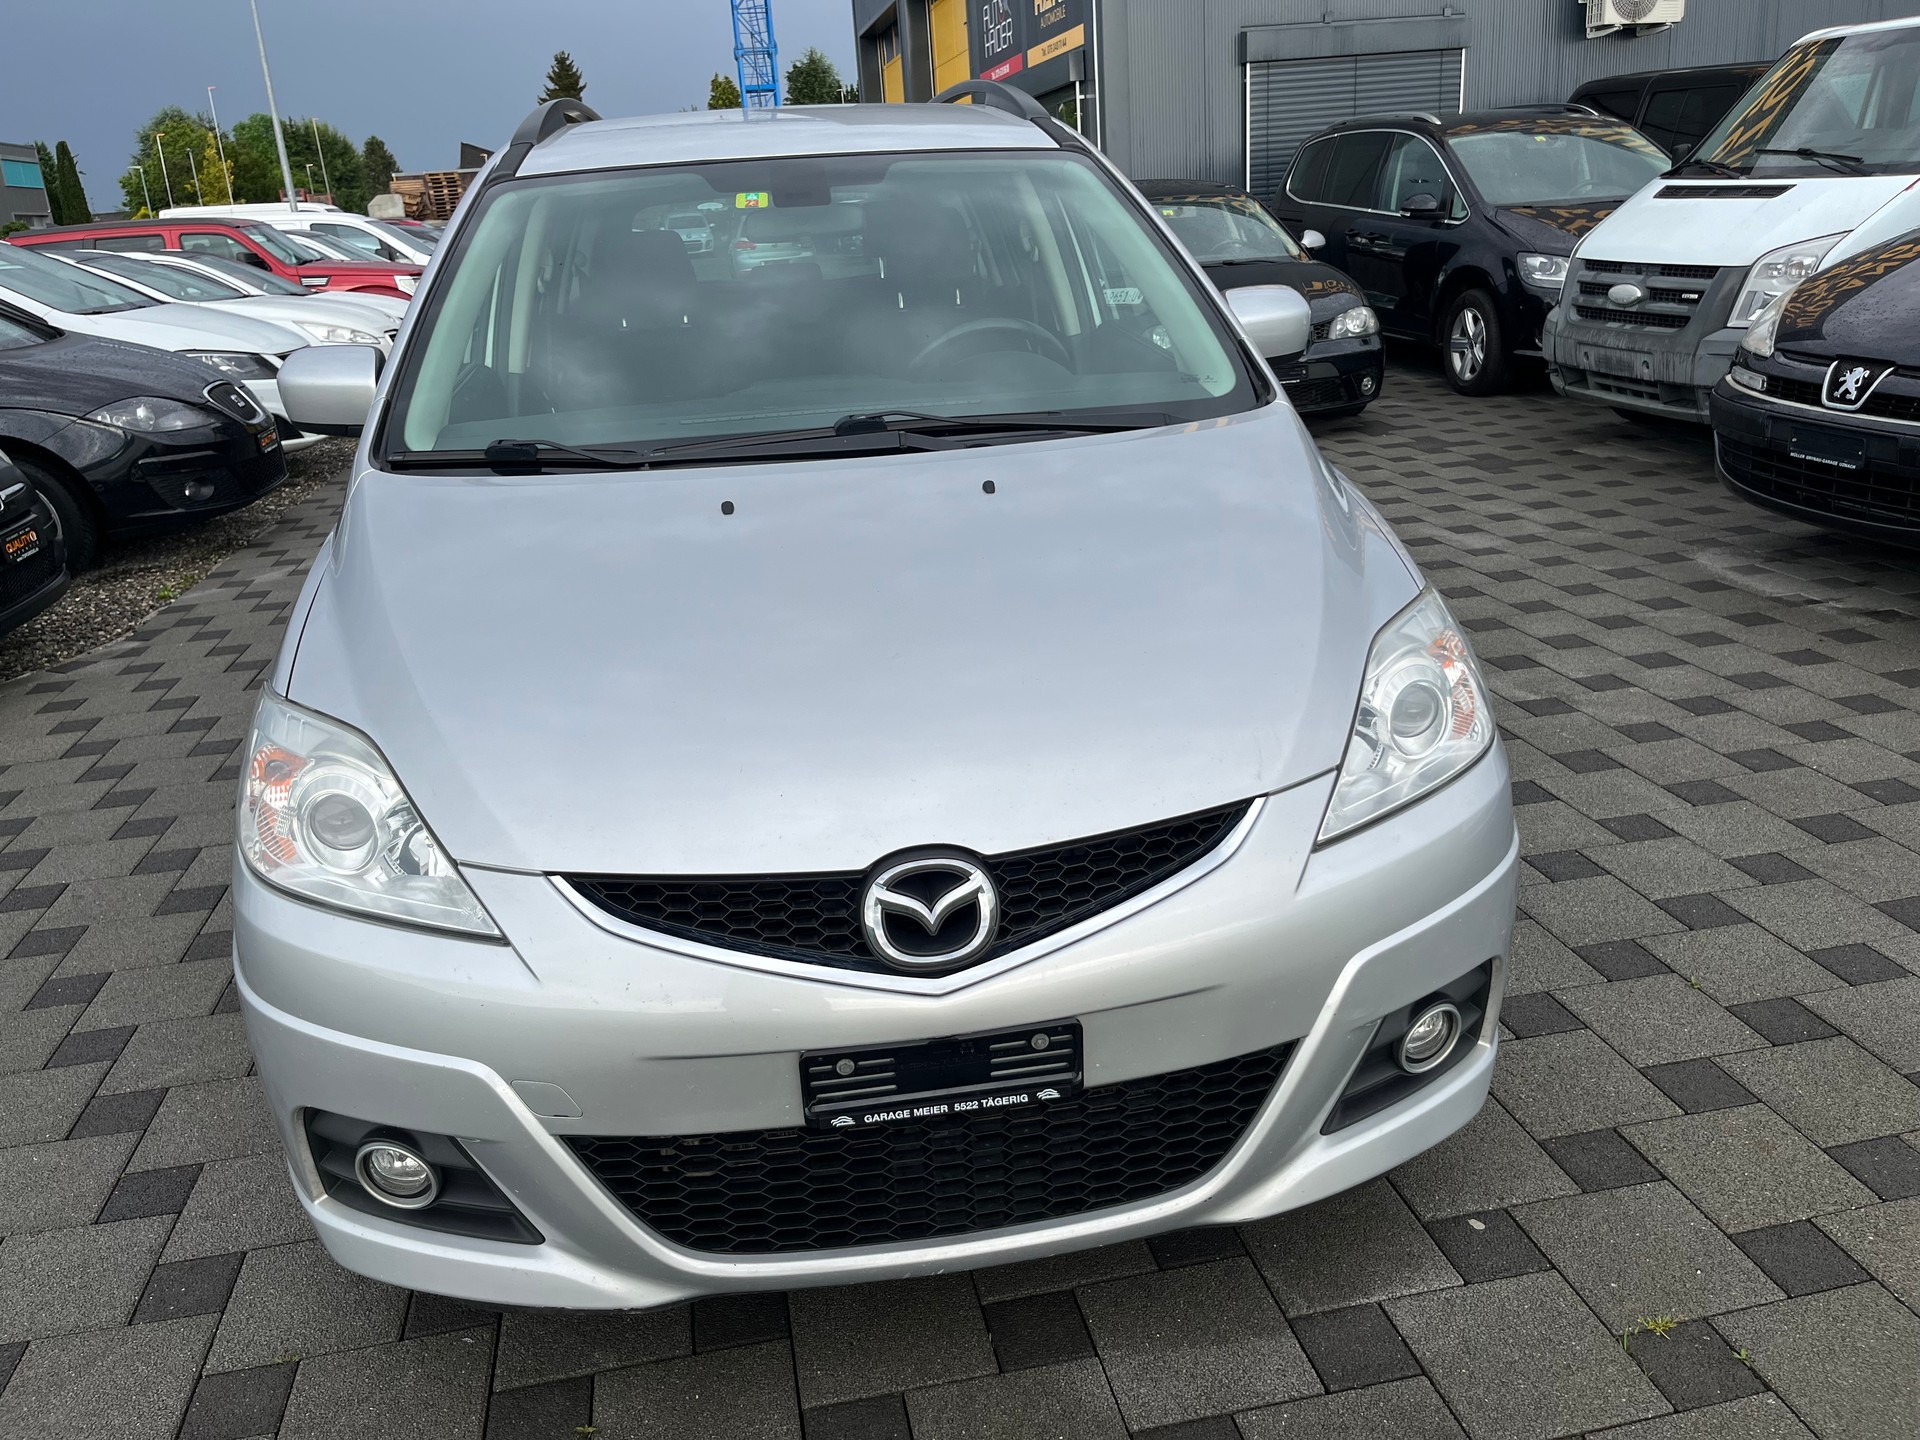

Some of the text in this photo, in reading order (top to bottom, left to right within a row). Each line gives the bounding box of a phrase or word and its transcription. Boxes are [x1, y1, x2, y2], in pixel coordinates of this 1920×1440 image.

[983, 18, 1013, 58] HAIDER
[864, 1094, 1028, 1123] GARAGE MEIER 5522 TÄGERIG
